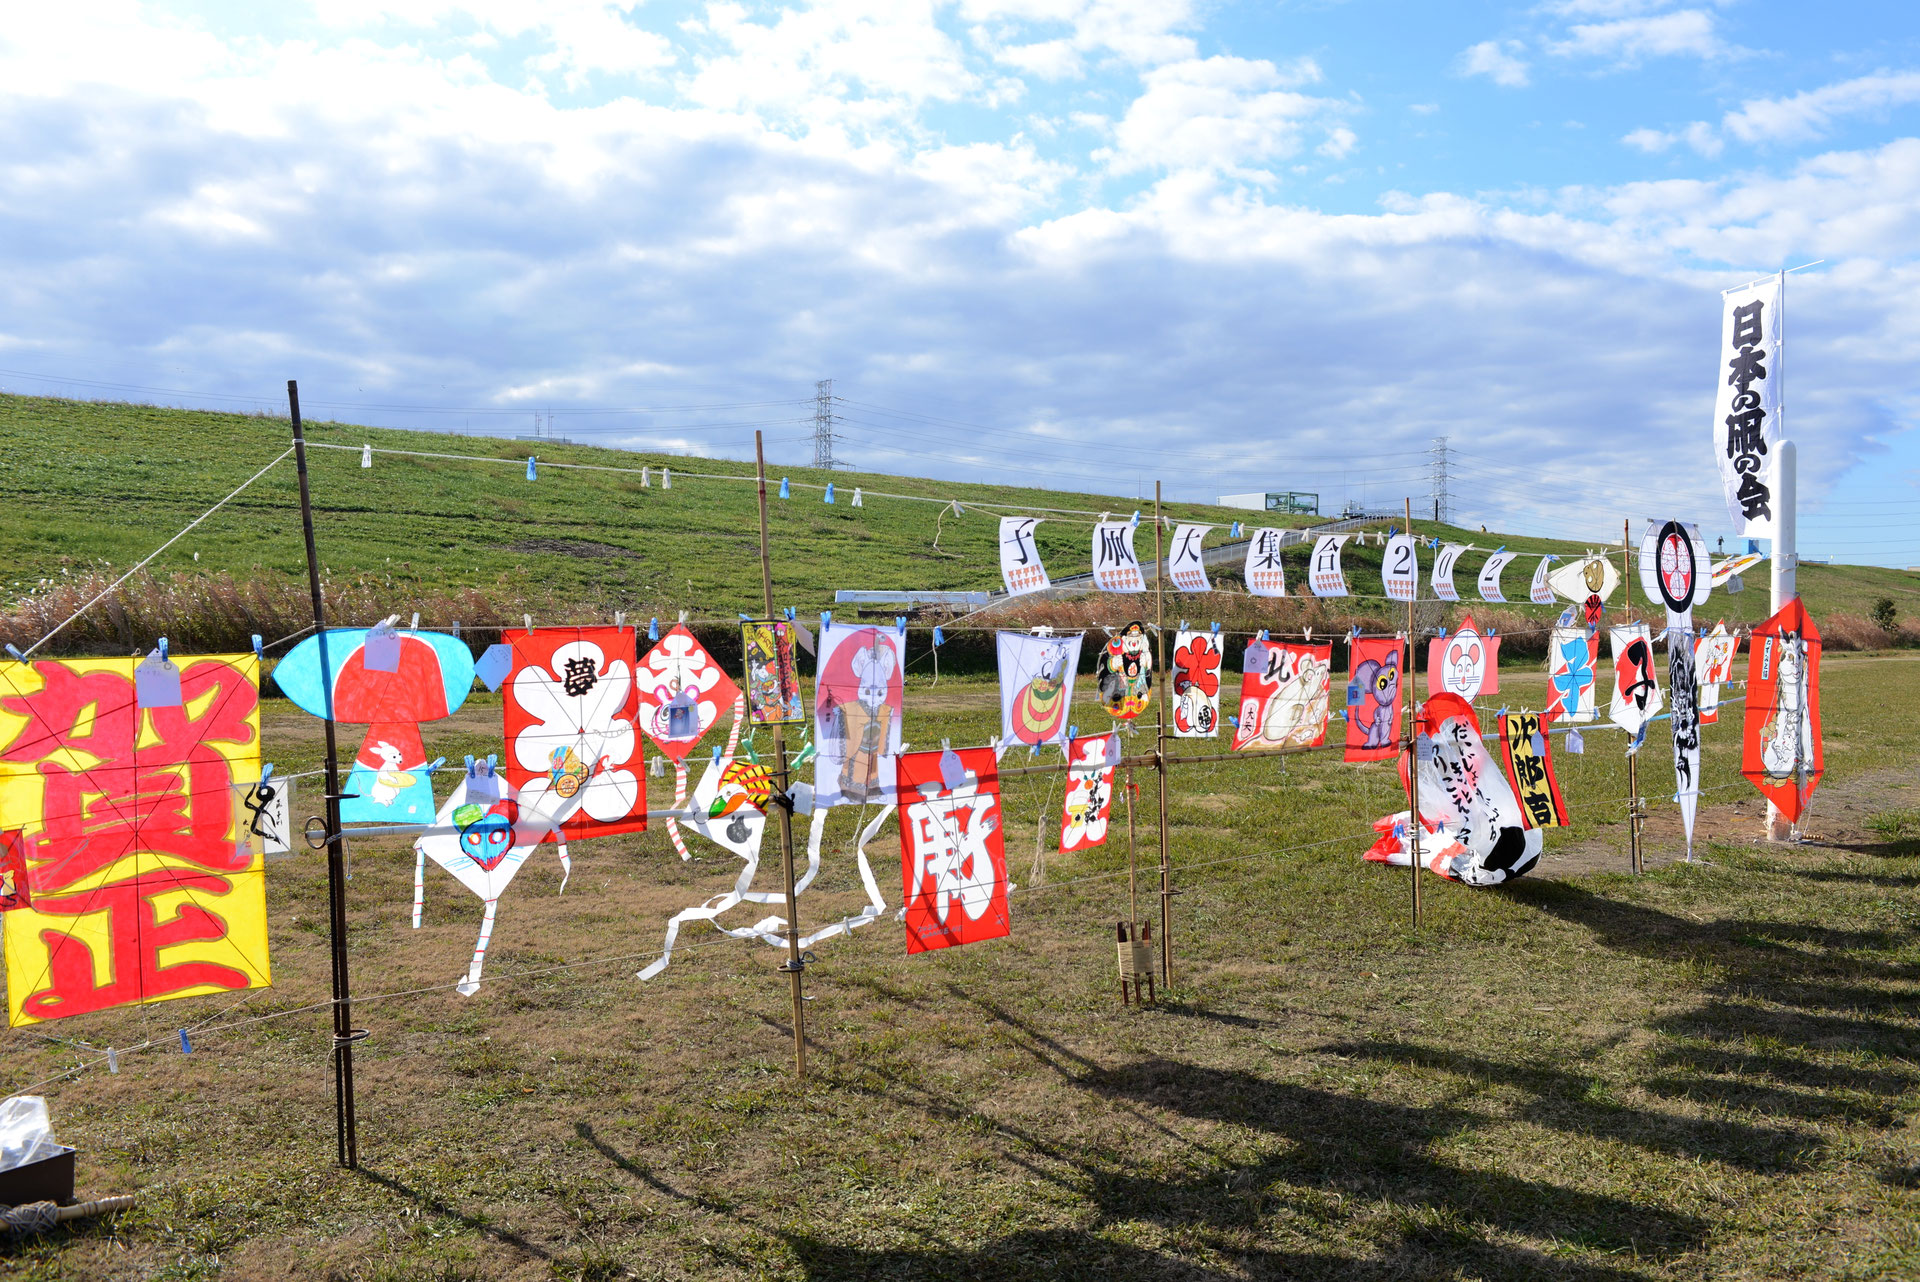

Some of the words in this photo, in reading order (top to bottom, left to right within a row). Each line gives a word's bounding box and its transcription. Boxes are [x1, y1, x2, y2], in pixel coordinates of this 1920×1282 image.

[1725, 299, 1772, 522] 日本の凧の会
[564, 657, 598, 697] 夢
[1624, 640, 1656, 711] 子
[1450, 762, 1473, 804] きっと
[1510, 716, 1552, 826] 次郎吉
[0, 661, 260, 1020] 賀正
